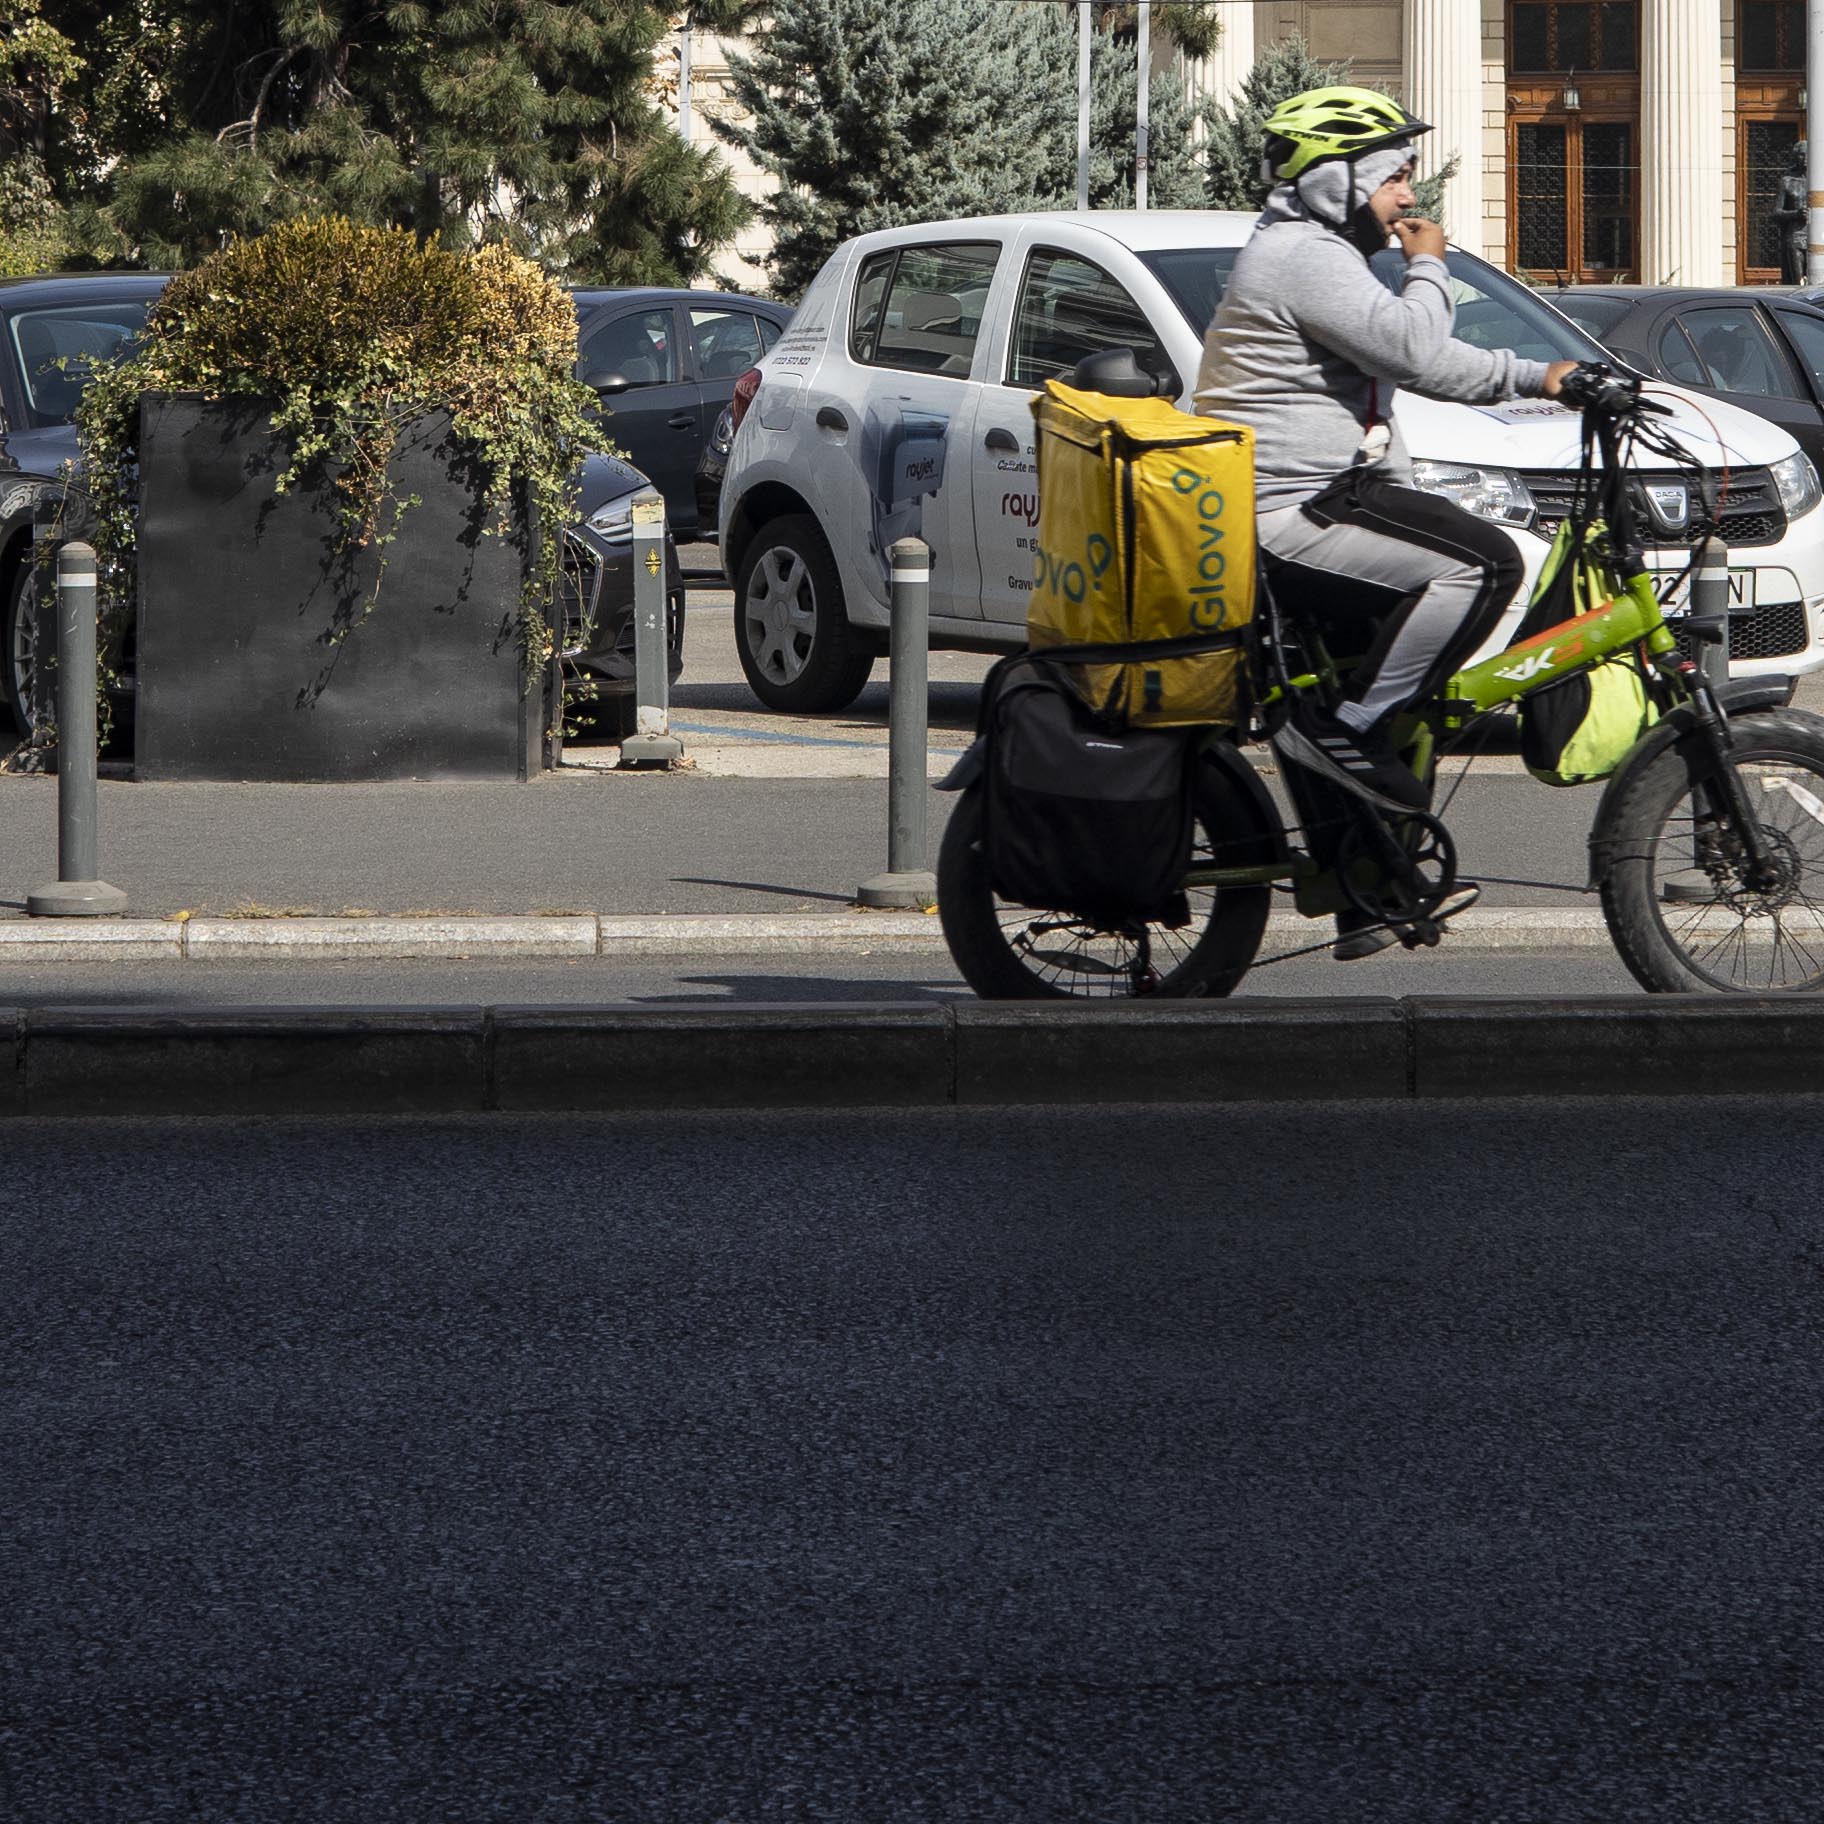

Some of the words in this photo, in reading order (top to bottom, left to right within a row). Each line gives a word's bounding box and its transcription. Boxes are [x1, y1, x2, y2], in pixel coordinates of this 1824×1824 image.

[906, 458, 934, 480] rayjet
[1016, 538, 1027, 548] un
[1189, 490, 1225, 630] Glovo
